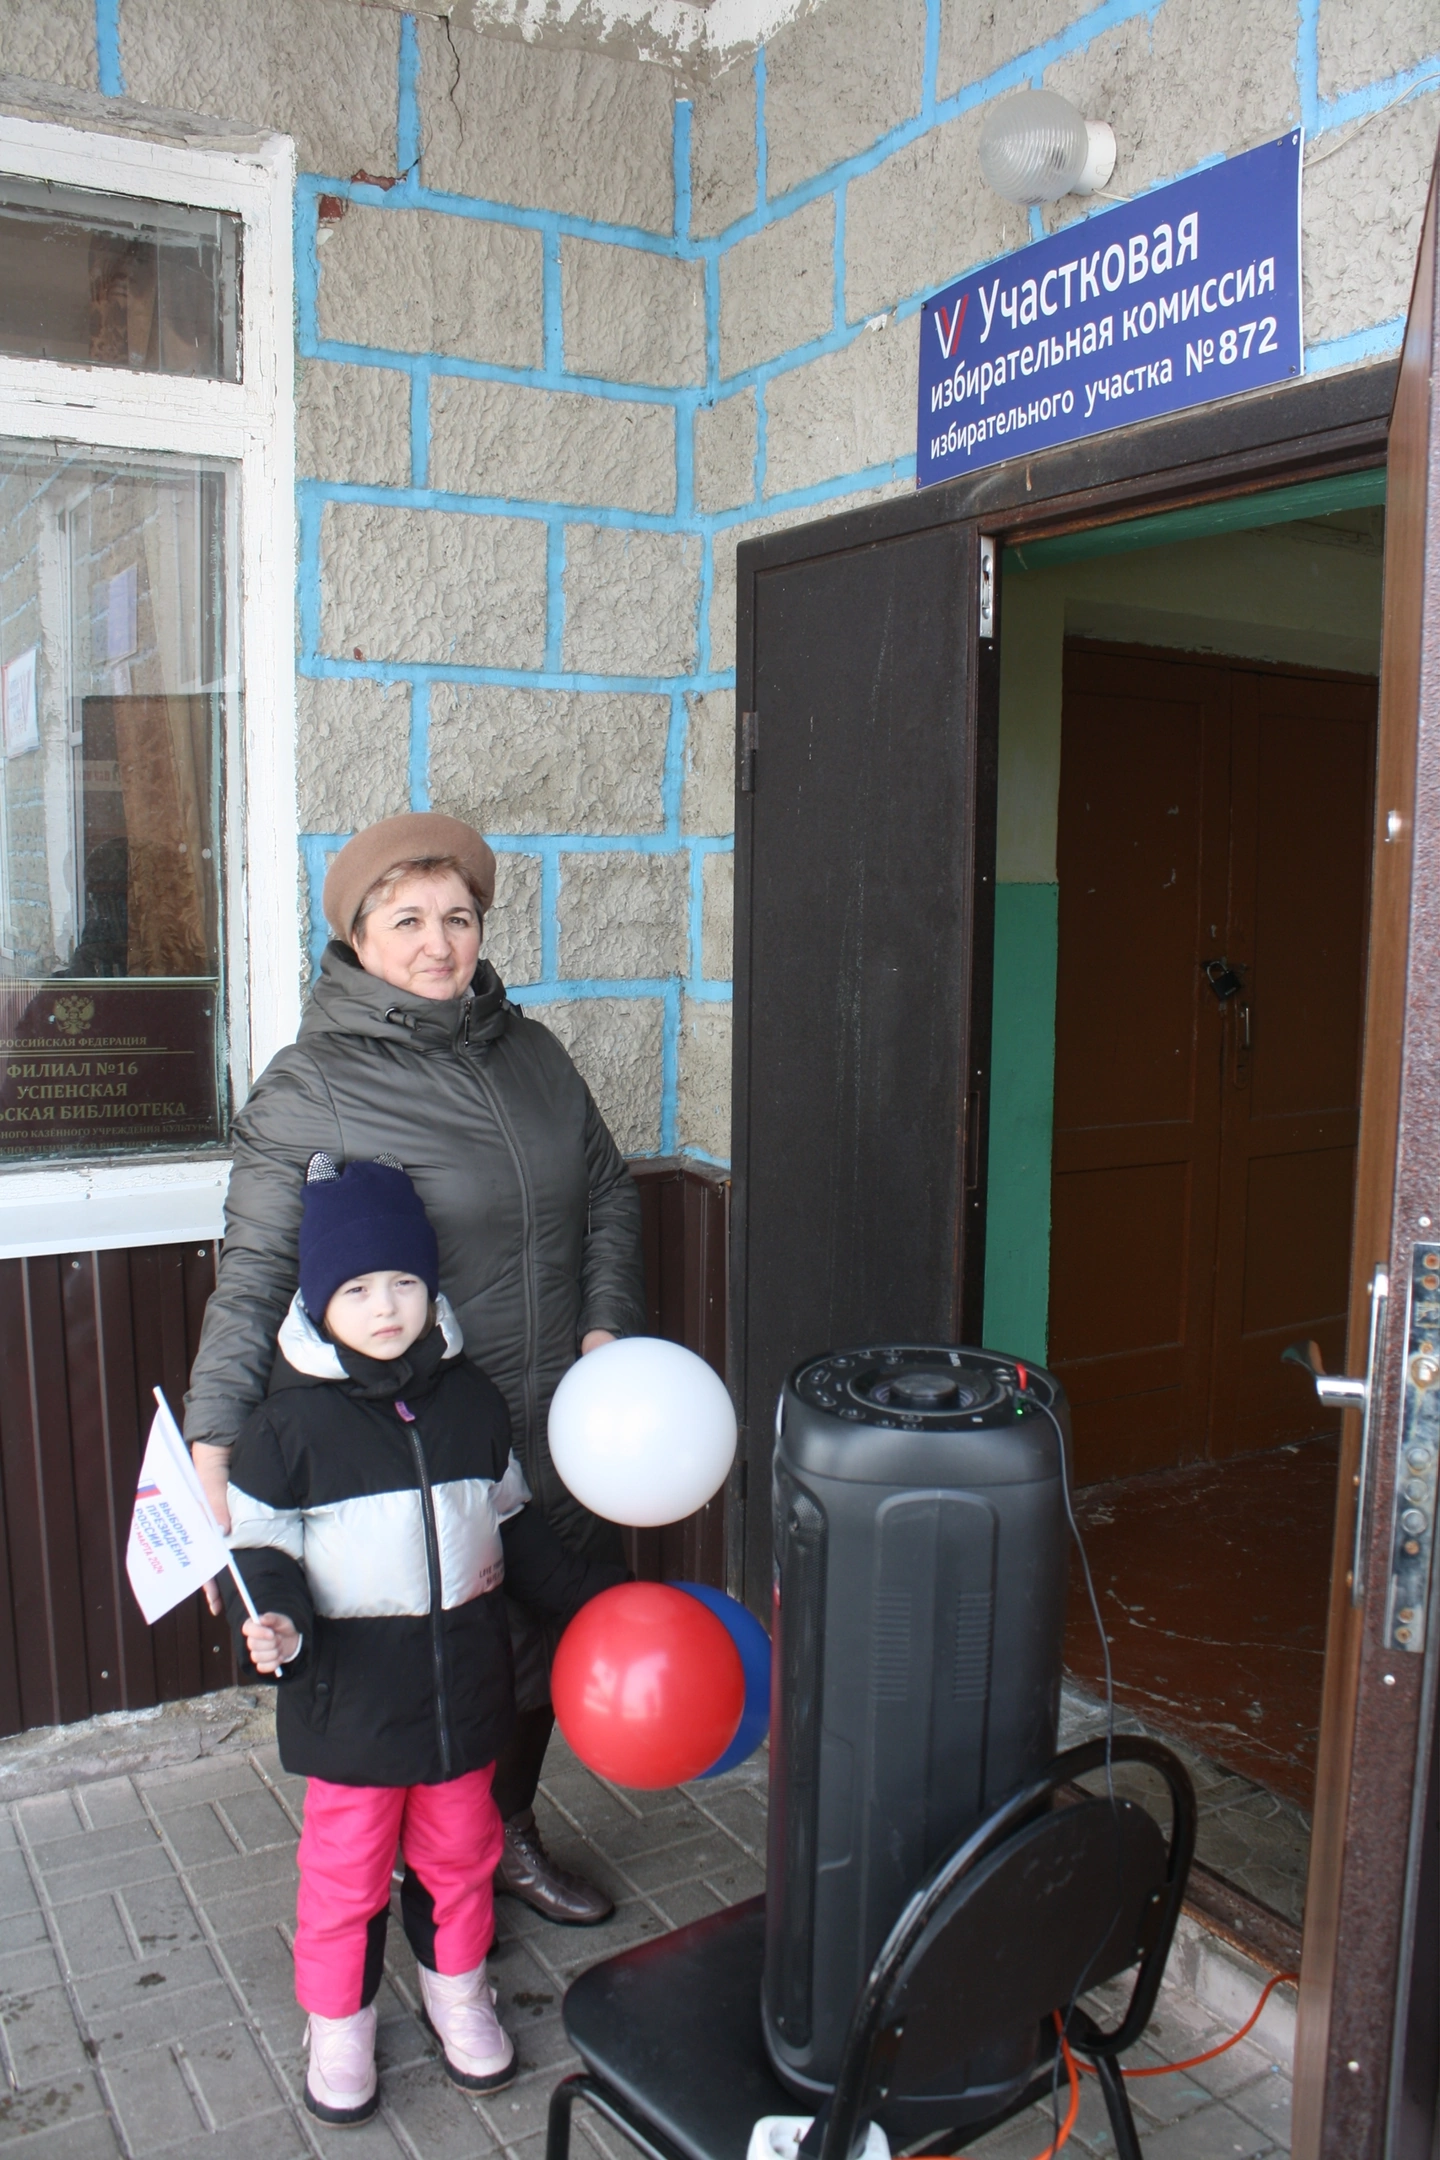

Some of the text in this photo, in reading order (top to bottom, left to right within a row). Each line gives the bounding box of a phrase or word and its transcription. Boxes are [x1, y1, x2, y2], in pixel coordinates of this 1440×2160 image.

[978, 211, 1199, 343] Участковая
[931, 257, 1275, 412] избирательная комиссия
[930, 389, 1074, 459] избирательного
[1084, 358, 1173, 417] участка
[0, 1036, 147, 1048] РОССИЙСКАЯ ФЕДЕРАЦИЯ
[6, 1063, 91, 1078] ФИЛИАЛ
[17, 1082, 128, 1099] УСПЕНСКАЯ
[60, 1102, 187, 1119] БИБЛИОТЕКА
[136, 1508, 164, 1548] РОССИИ
[145, 1504, 191, 1568] ПРЕЗИДЕНТА
[159, 1502, 193, 1545] ВЫБОРЫ
